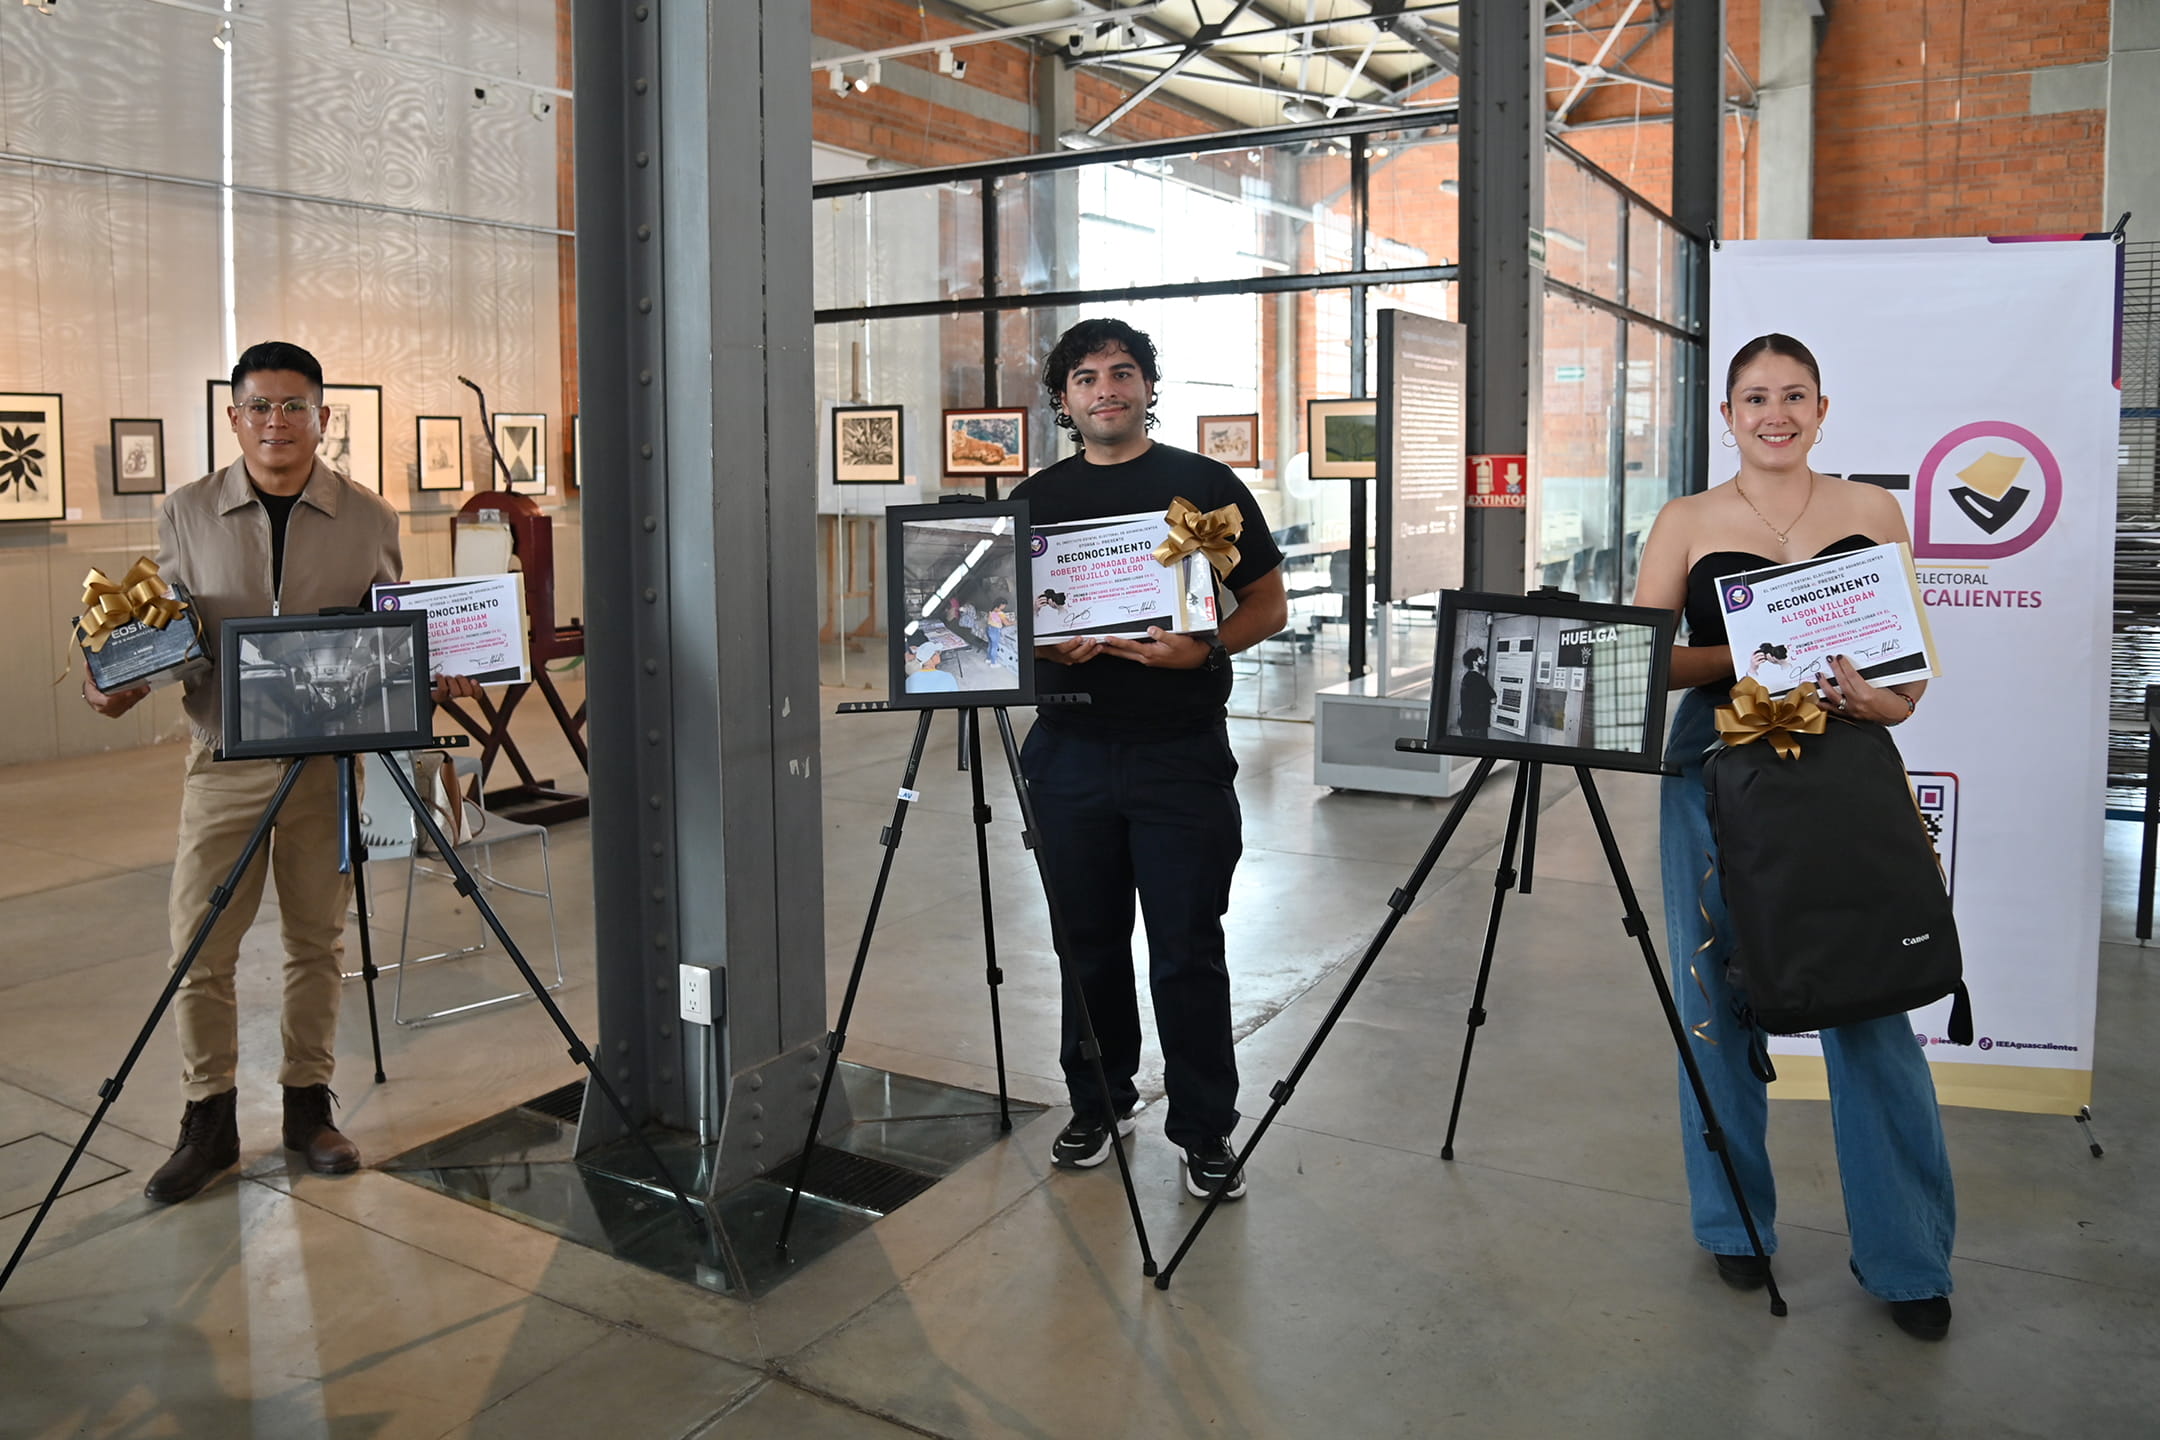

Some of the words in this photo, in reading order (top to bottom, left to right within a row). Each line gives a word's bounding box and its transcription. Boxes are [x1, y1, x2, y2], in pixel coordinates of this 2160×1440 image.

[1057, 540, 1151, 564] RECONOCIMIENTO
[1050, 565, 1087, 577] ROBERTO
[1090, 558, 1127, 571] JONADAB
[1129, 553, 1155, 564] DANIE
[1069, 569, 1110, 583] TRUJILLO
[1112, 564, 1144, 575] VALERO
[1916, 573, 1989, 585] ELECTORAL
[1767, 573, 1880, 613] RECONOCIMIENTO
[1920, 588, 2043, 609] CALIENTES
[427, 599, 499, 619] ONOCIMIENTO
[1781, 607, 1817, 624] ALISON
[429, 620, 448, 630] RICK
[451, 613, 487, 626] ABRAHAM
[463, 621, 488, 631] ROJAS
[111, 623, 138, 639] EOS
[1561, 627, 1618, 646] HUELGA
[1902, 933, 1930, 946] Canon
[1996, 1040, 2079, 1052] IEEAguascalientes
